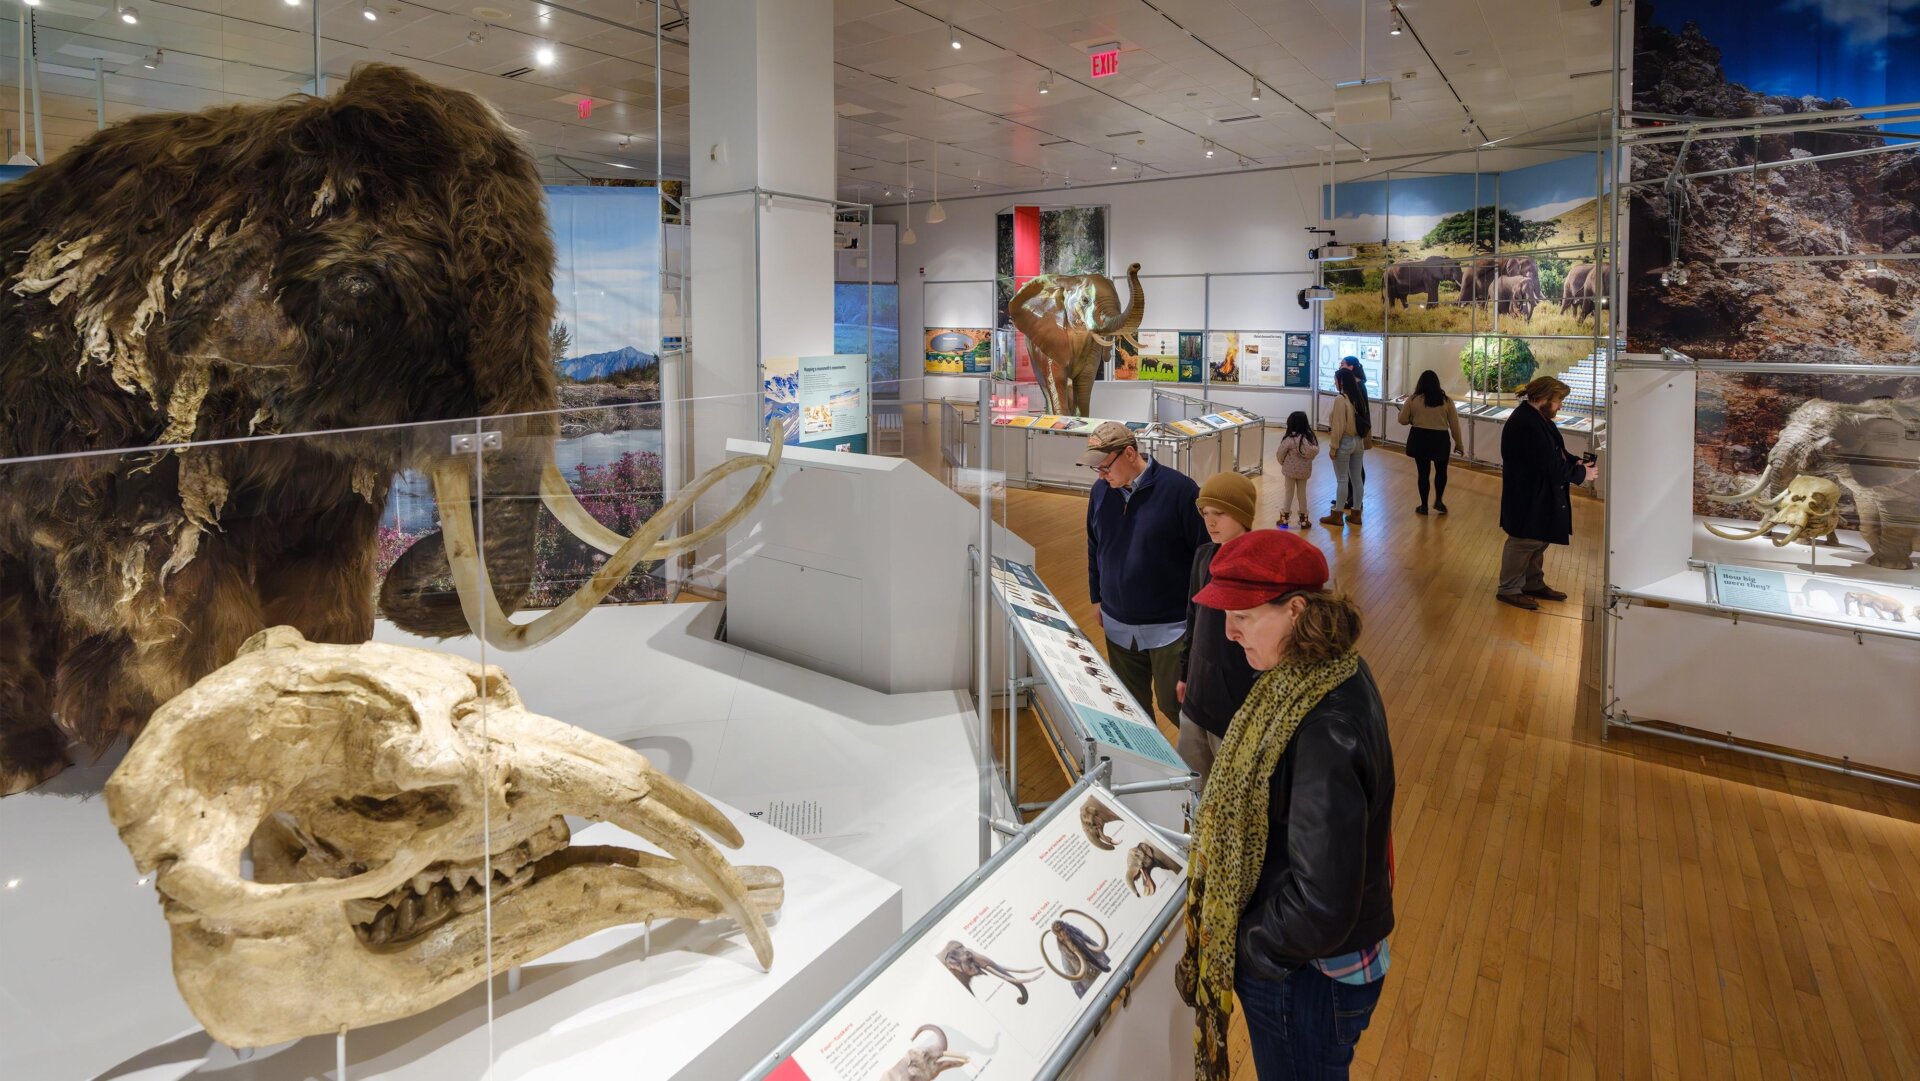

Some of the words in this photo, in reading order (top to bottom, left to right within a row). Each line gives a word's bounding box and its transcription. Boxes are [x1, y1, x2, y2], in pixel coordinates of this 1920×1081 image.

[1092, 51, 1117, 77] EXIT
[1723, 573, 1741, 581] How
[1742, 575, 1757, 584] big
[1746, 582, 1770, 591] they?
[820, 1022, 854, 1054] Four-tuskers
